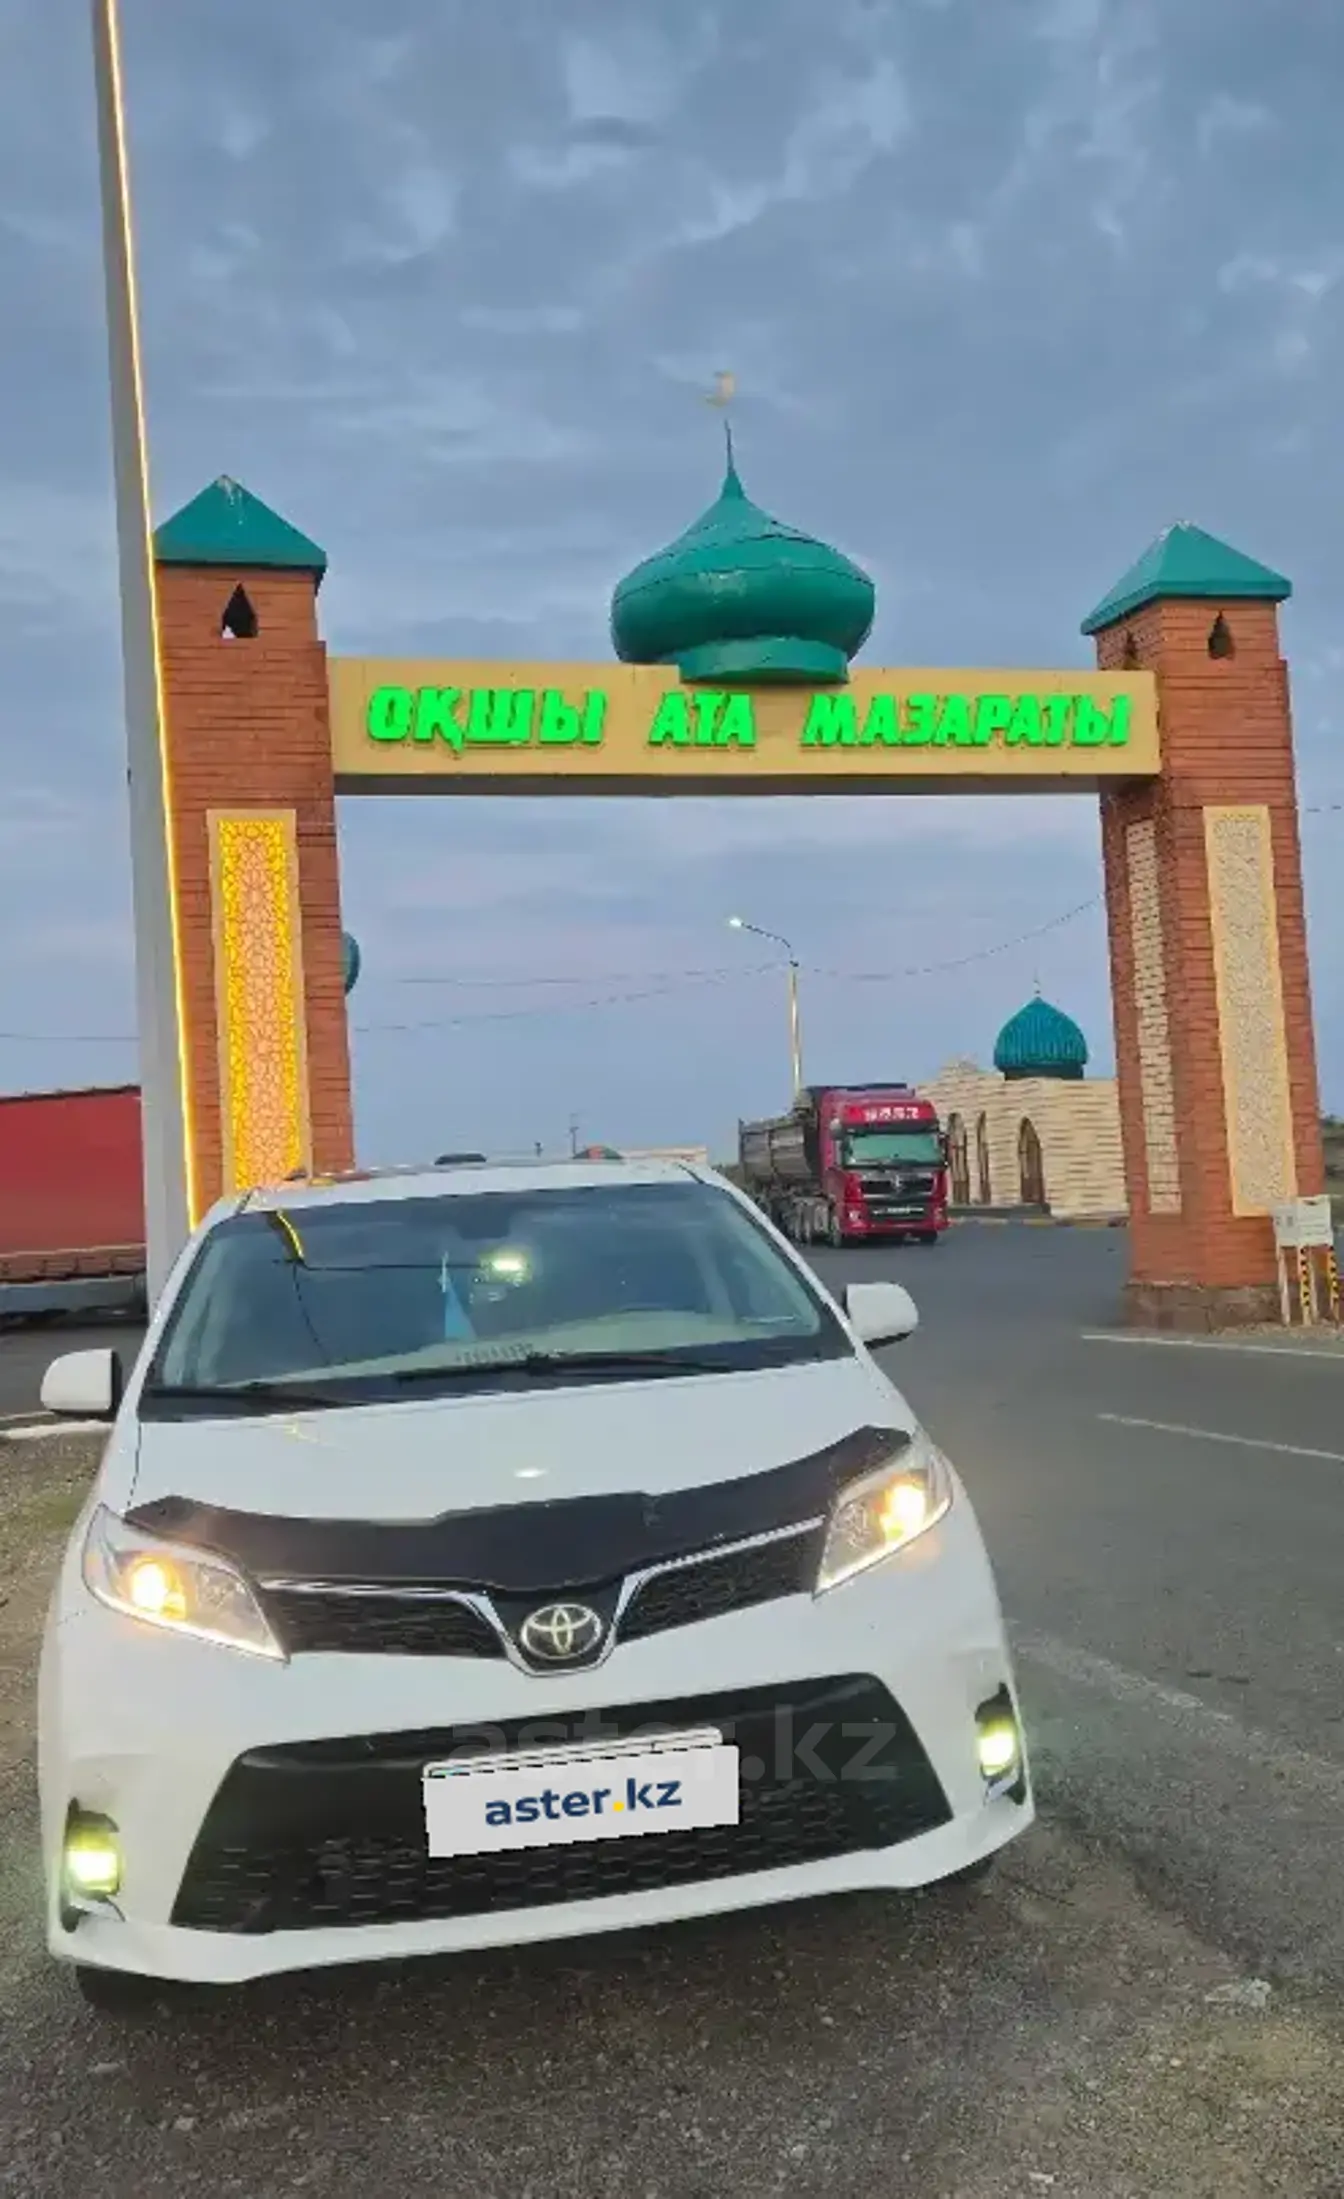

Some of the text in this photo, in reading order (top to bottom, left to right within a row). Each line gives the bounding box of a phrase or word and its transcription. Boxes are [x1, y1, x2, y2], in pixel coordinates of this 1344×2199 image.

[366, 684, 1133, 753] ОҚШЫ АТА МАЗАРАТЫ
